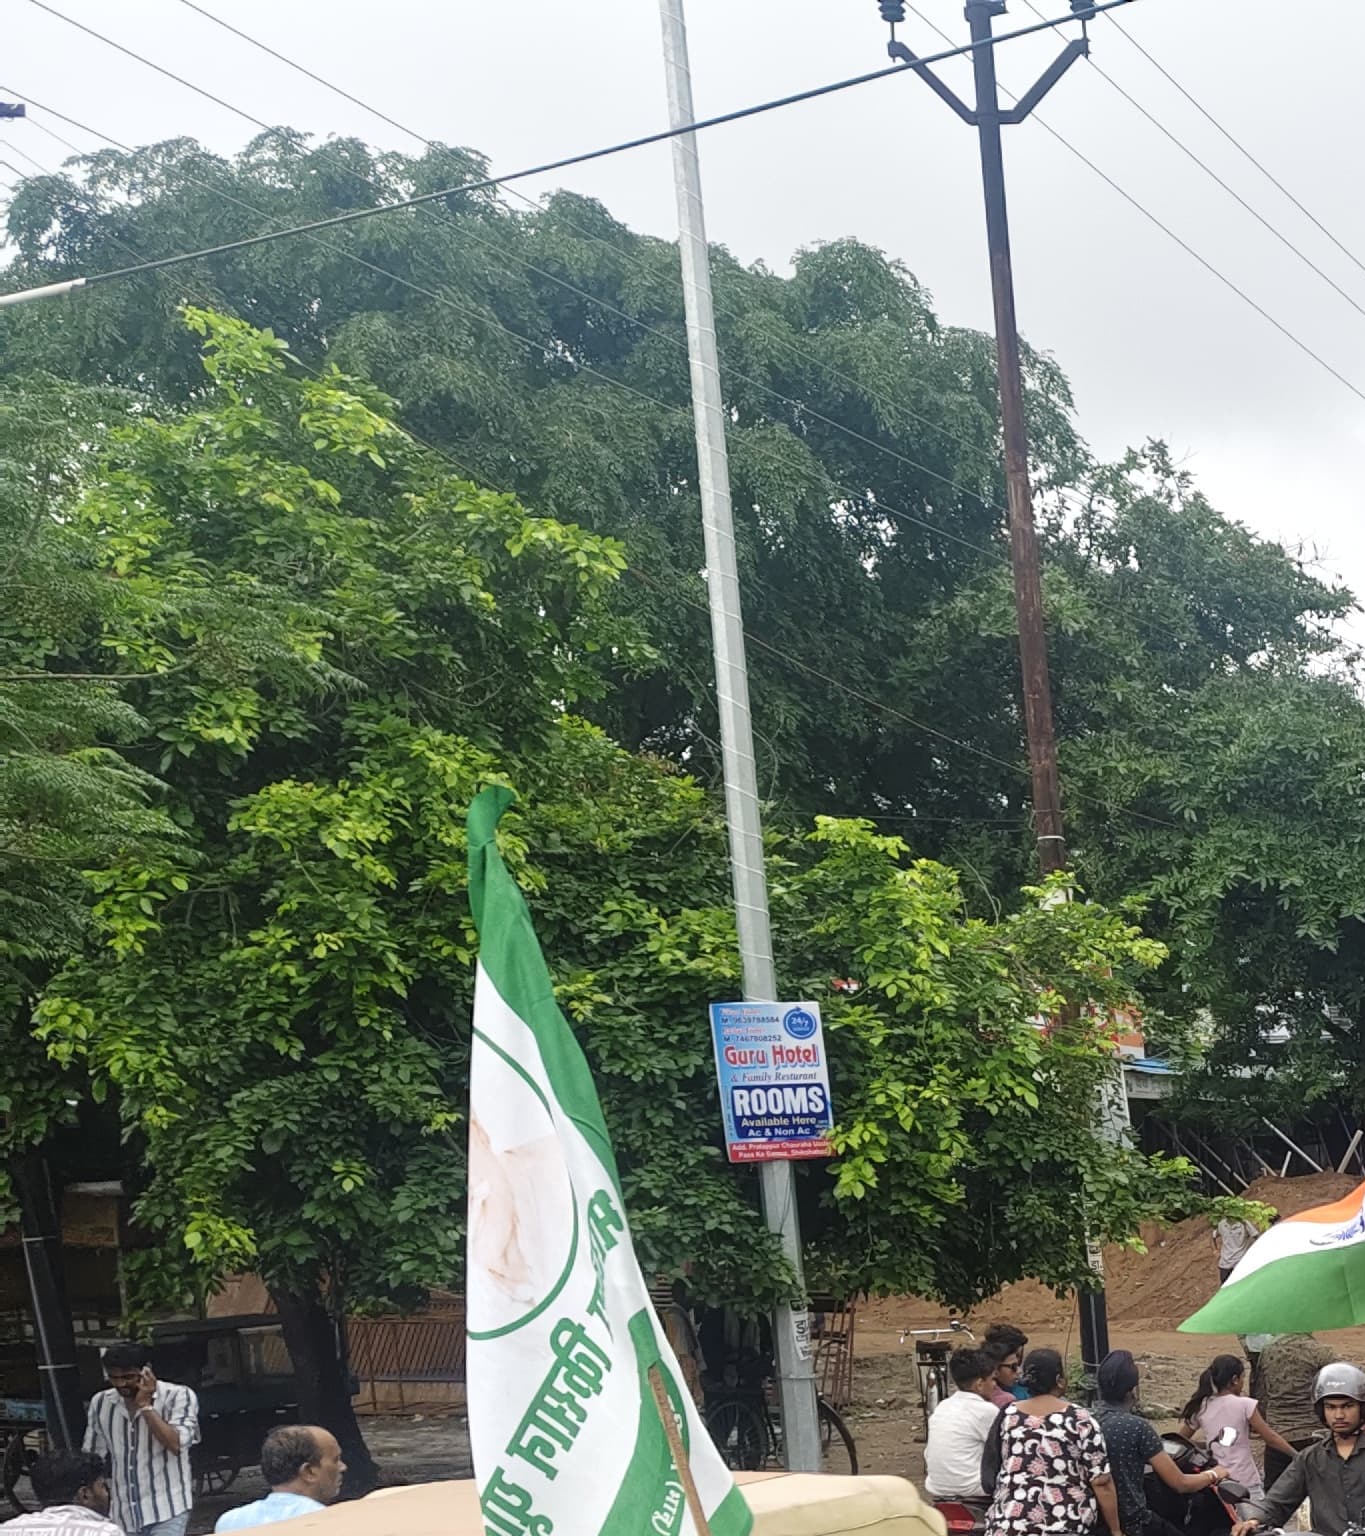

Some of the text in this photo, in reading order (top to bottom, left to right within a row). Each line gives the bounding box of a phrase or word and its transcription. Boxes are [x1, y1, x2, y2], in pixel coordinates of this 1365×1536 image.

[724, 1043, 819, 1067] Guru Hotel
[742, 1072, 772, 1083] Family
[732, 1087, 825, 1117] ROOMS
[741, 1115, 816, 1127] Available Here
[764, 1128, 772, 1137] &
[774, 1127, 794, 1136] Non
